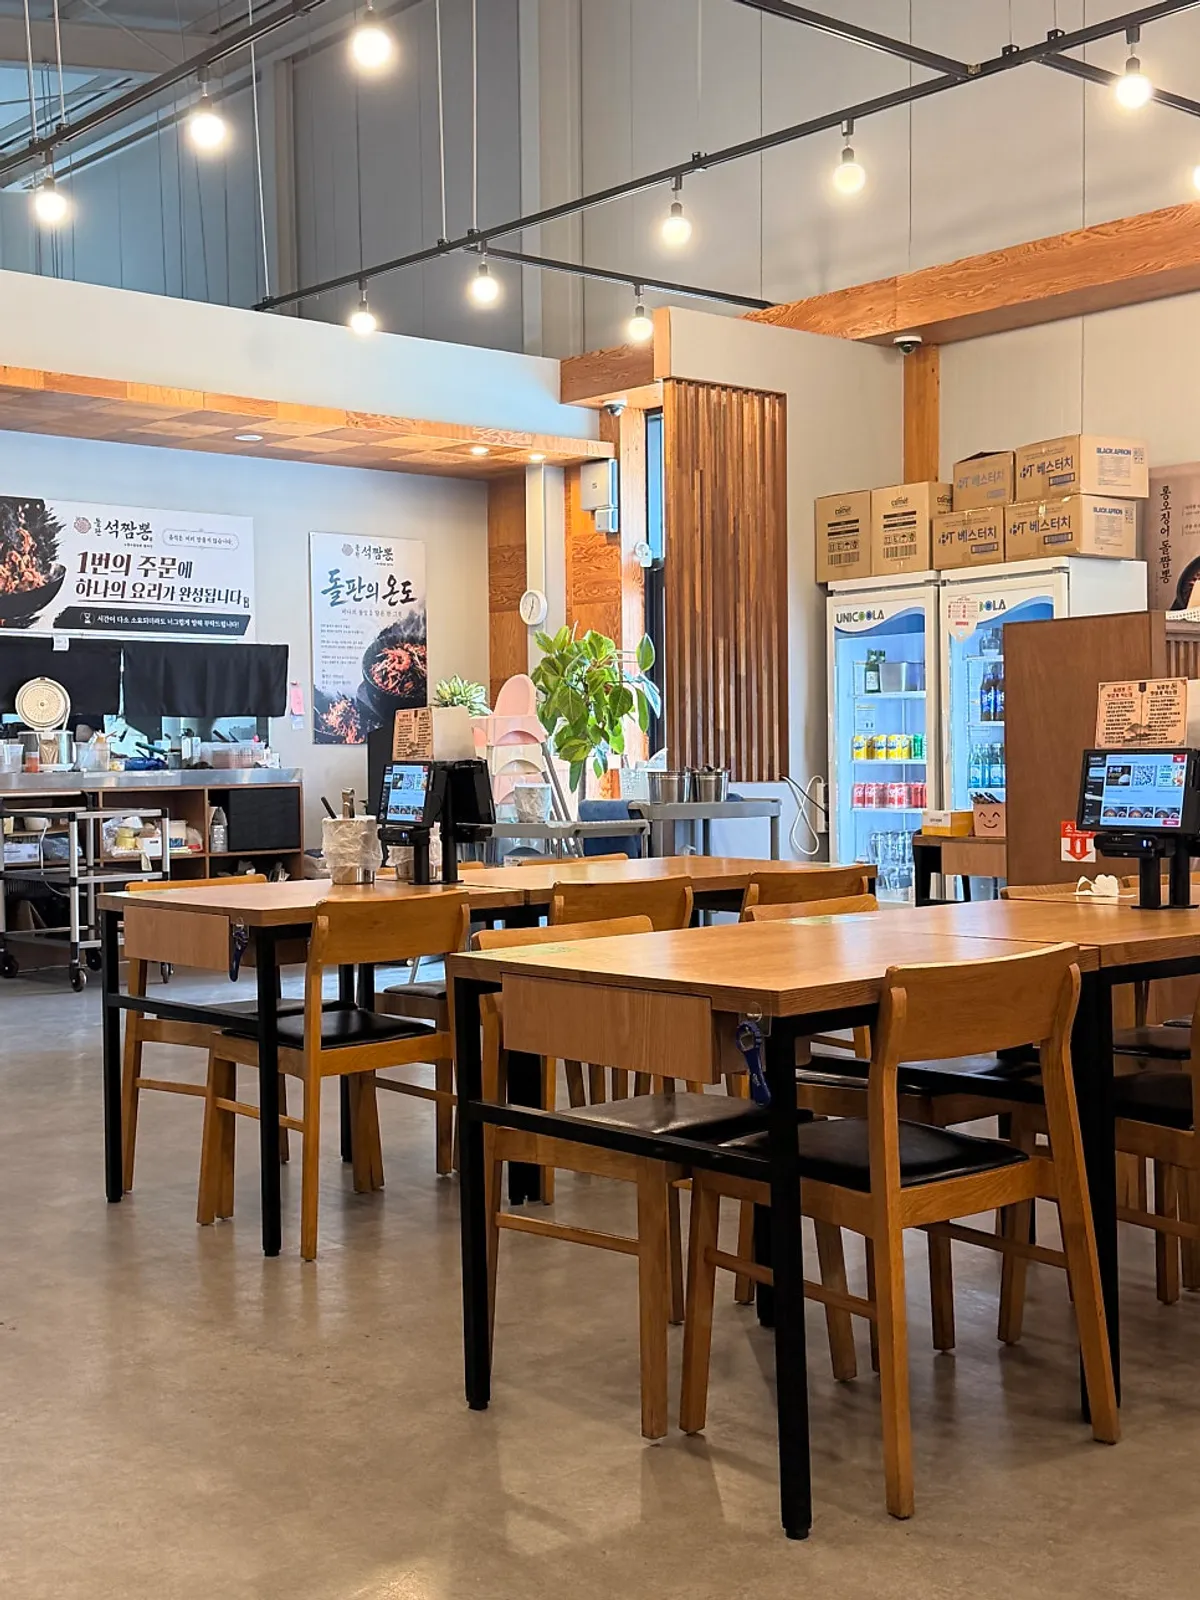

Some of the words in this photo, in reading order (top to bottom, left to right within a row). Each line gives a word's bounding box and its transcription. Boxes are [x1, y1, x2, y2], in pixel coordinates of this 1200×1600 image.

[1037, 455, 1074, 475] 베스터치
[972, 469, 1005, 487] 베스터치
[104, 519, 152, 541] 석짬뽕
[957, 525, 997, 543] 베스터치
[1029, 515, 1071, 533] 베스터치
[77, 551, 131, 576] 1번의
[136, 555, 192, 579] 주문에
[76, 578, 126, 599] 하나의
[130, 582, 176, 602] 요리가
[179, 586, 241, 605] 완성됩니다
[320, 569, 379, 607] 돌판의
[381, 574, 418, 606] 온도
[97, 615, 116, 624] 시간이
[116, 616, 130, 624] 다소
